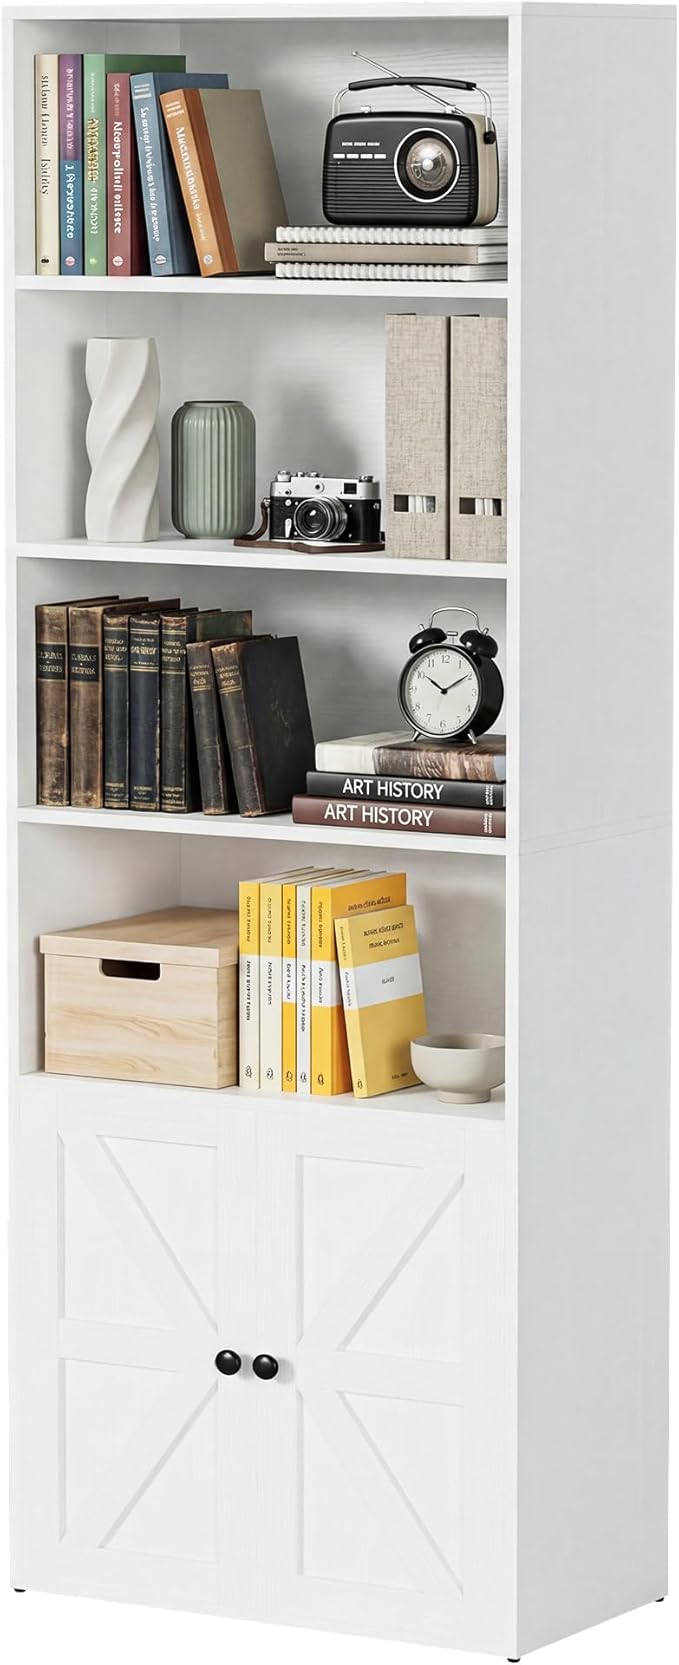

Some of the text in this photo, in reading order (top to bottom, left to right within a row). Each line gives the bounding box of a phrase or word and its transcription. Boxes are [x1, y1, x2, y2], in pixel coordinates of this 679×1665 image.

[342, 778, 444, 800] ART HISTORY
[323, 803, 434, 827] ART HISTORY
